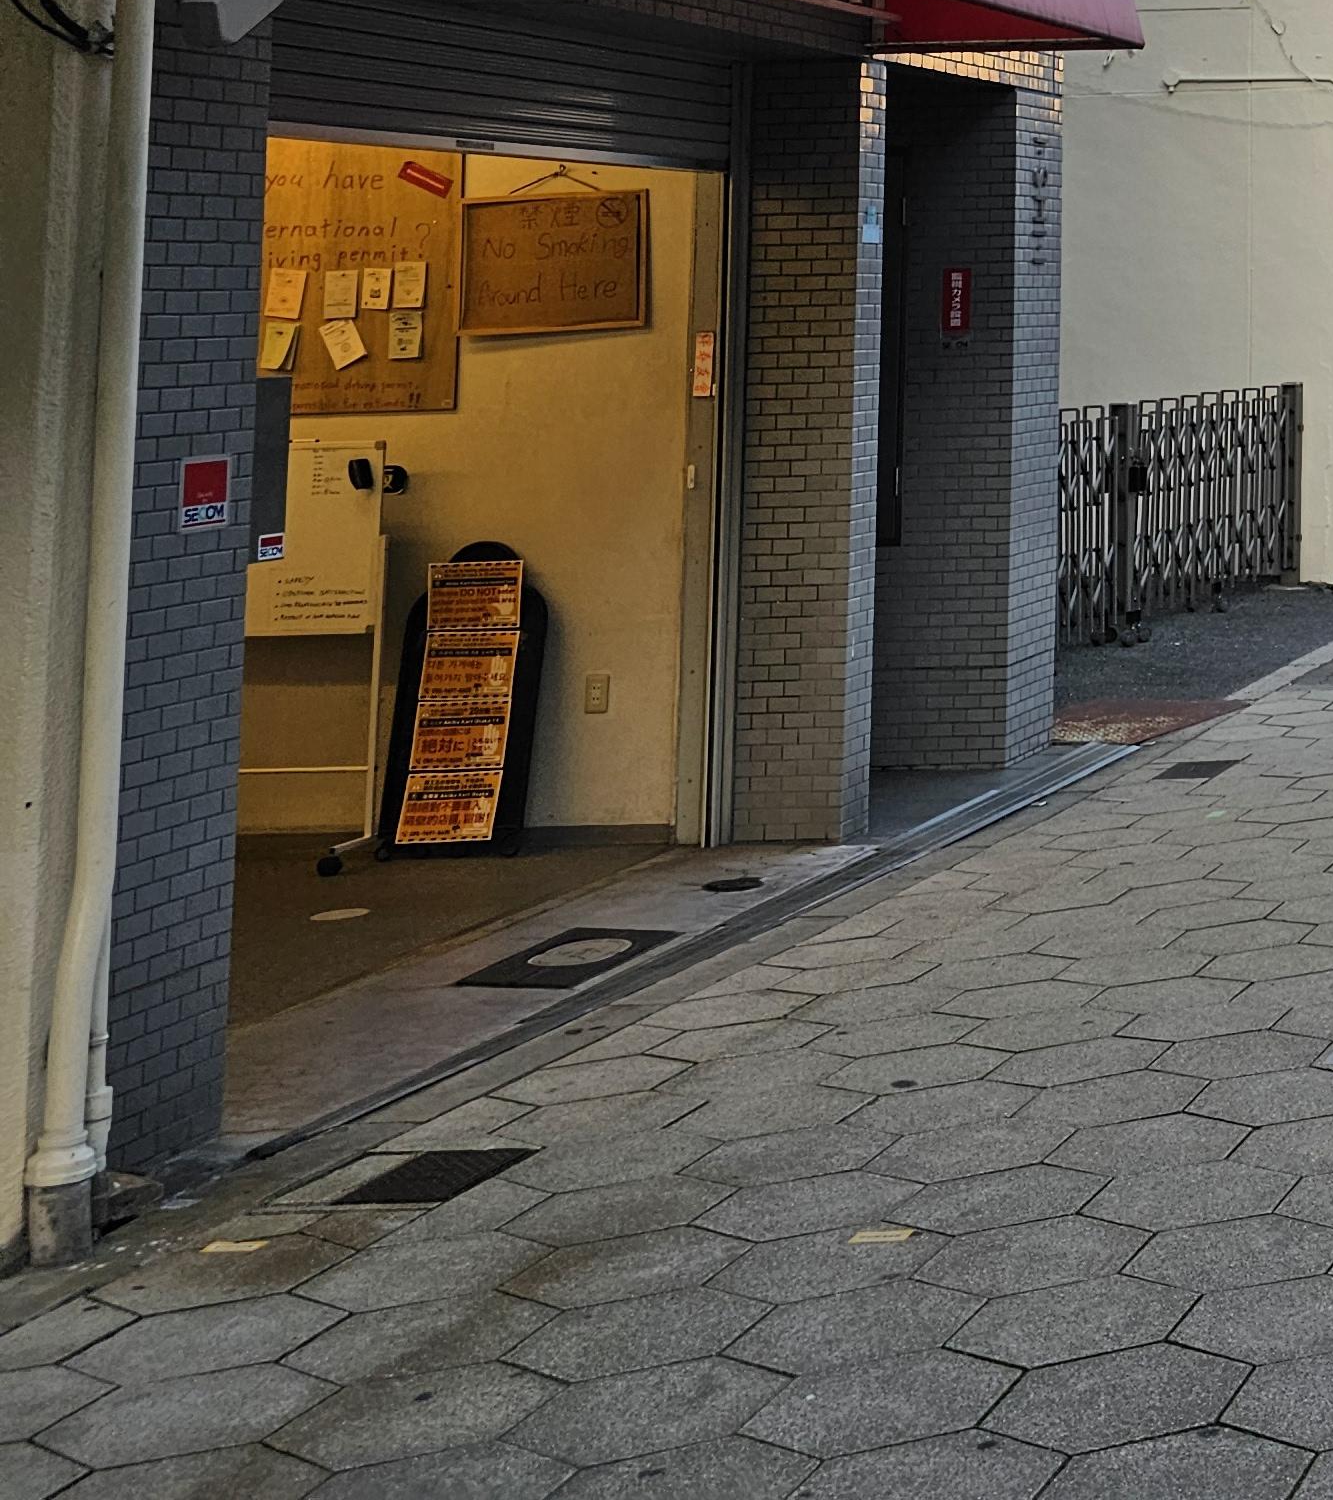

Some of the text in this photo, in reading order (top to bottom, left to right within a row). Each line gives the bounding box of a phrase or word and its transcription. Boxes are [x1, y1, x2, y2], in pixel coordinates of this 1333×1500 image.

[266, 160, 384, 195] you have
[483, 232, 629, 260] No Smoking
[478, 271, 617, 306] Around Here
[184, 504, 224, 524] SECOM
[460, 588, 476, 597] DO
[477, 587, 496, 596] NOT
